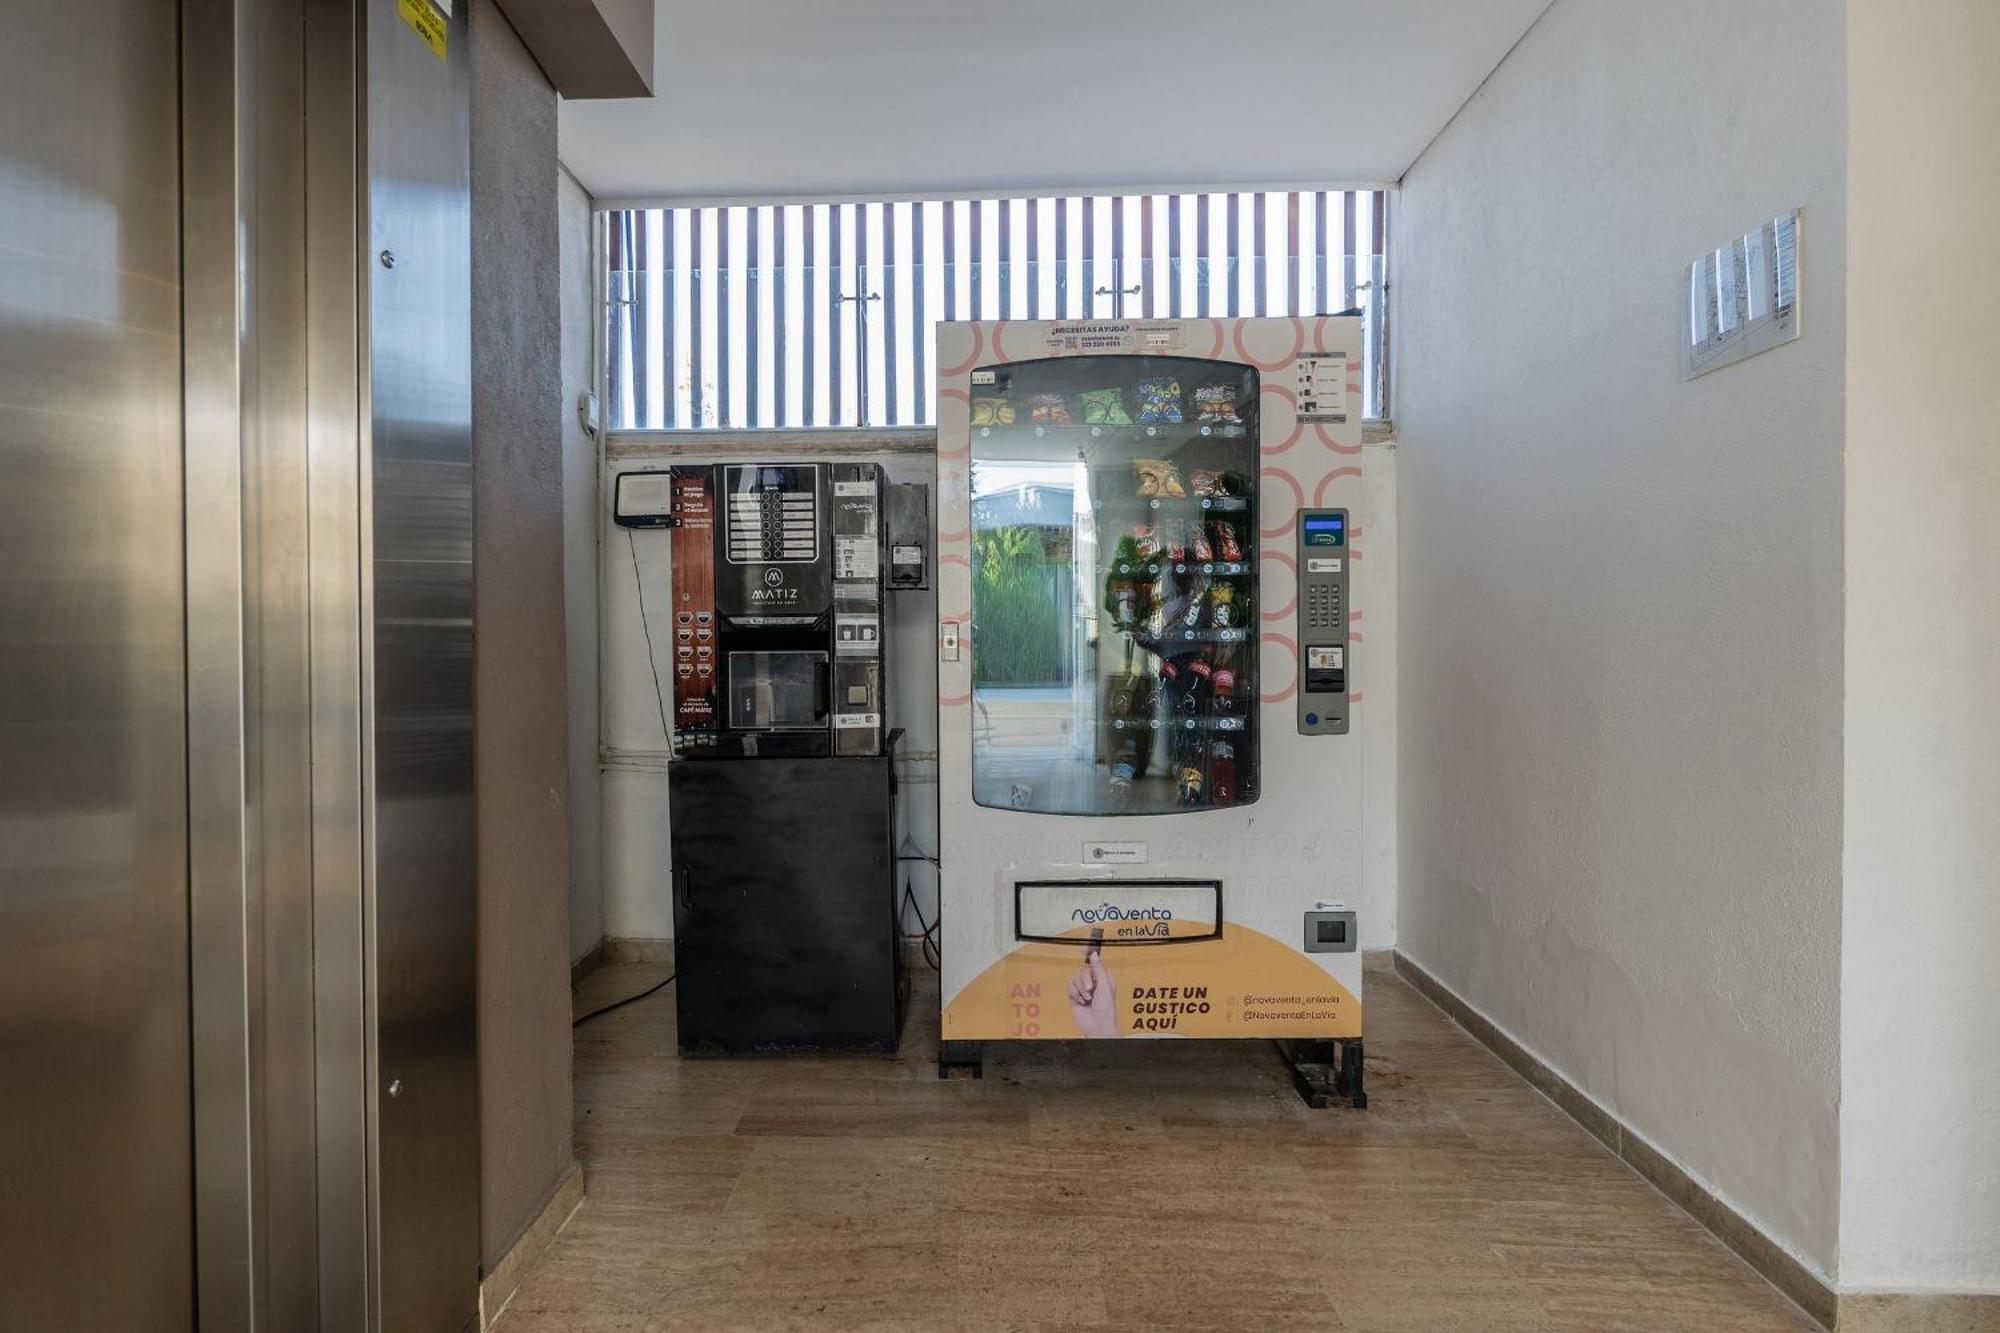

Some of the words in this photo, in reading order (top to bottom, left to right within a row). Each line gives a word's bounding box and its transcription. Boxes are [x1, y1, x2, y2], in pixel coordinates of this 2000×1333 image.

[1098, 325, 1130, 333] AYUDA?
[751, 588, 797, 600] MATIZ
[1071, 905, 1172, 923] novaventa
[1118, 928, 1133, 936] en
[1011, 983, 1041, 998] AN
[1133, 987, 1178, 999] DATE
[1183, 987, 1207, 999] UN
[1013, 1003, 1040, 1017] TO
[1133, 1002, 1210, 1014] GUSTICO
[1012, 1022, 1040, 1036] JO
[1132, 1014, 1178, 1031] AQUÍ
